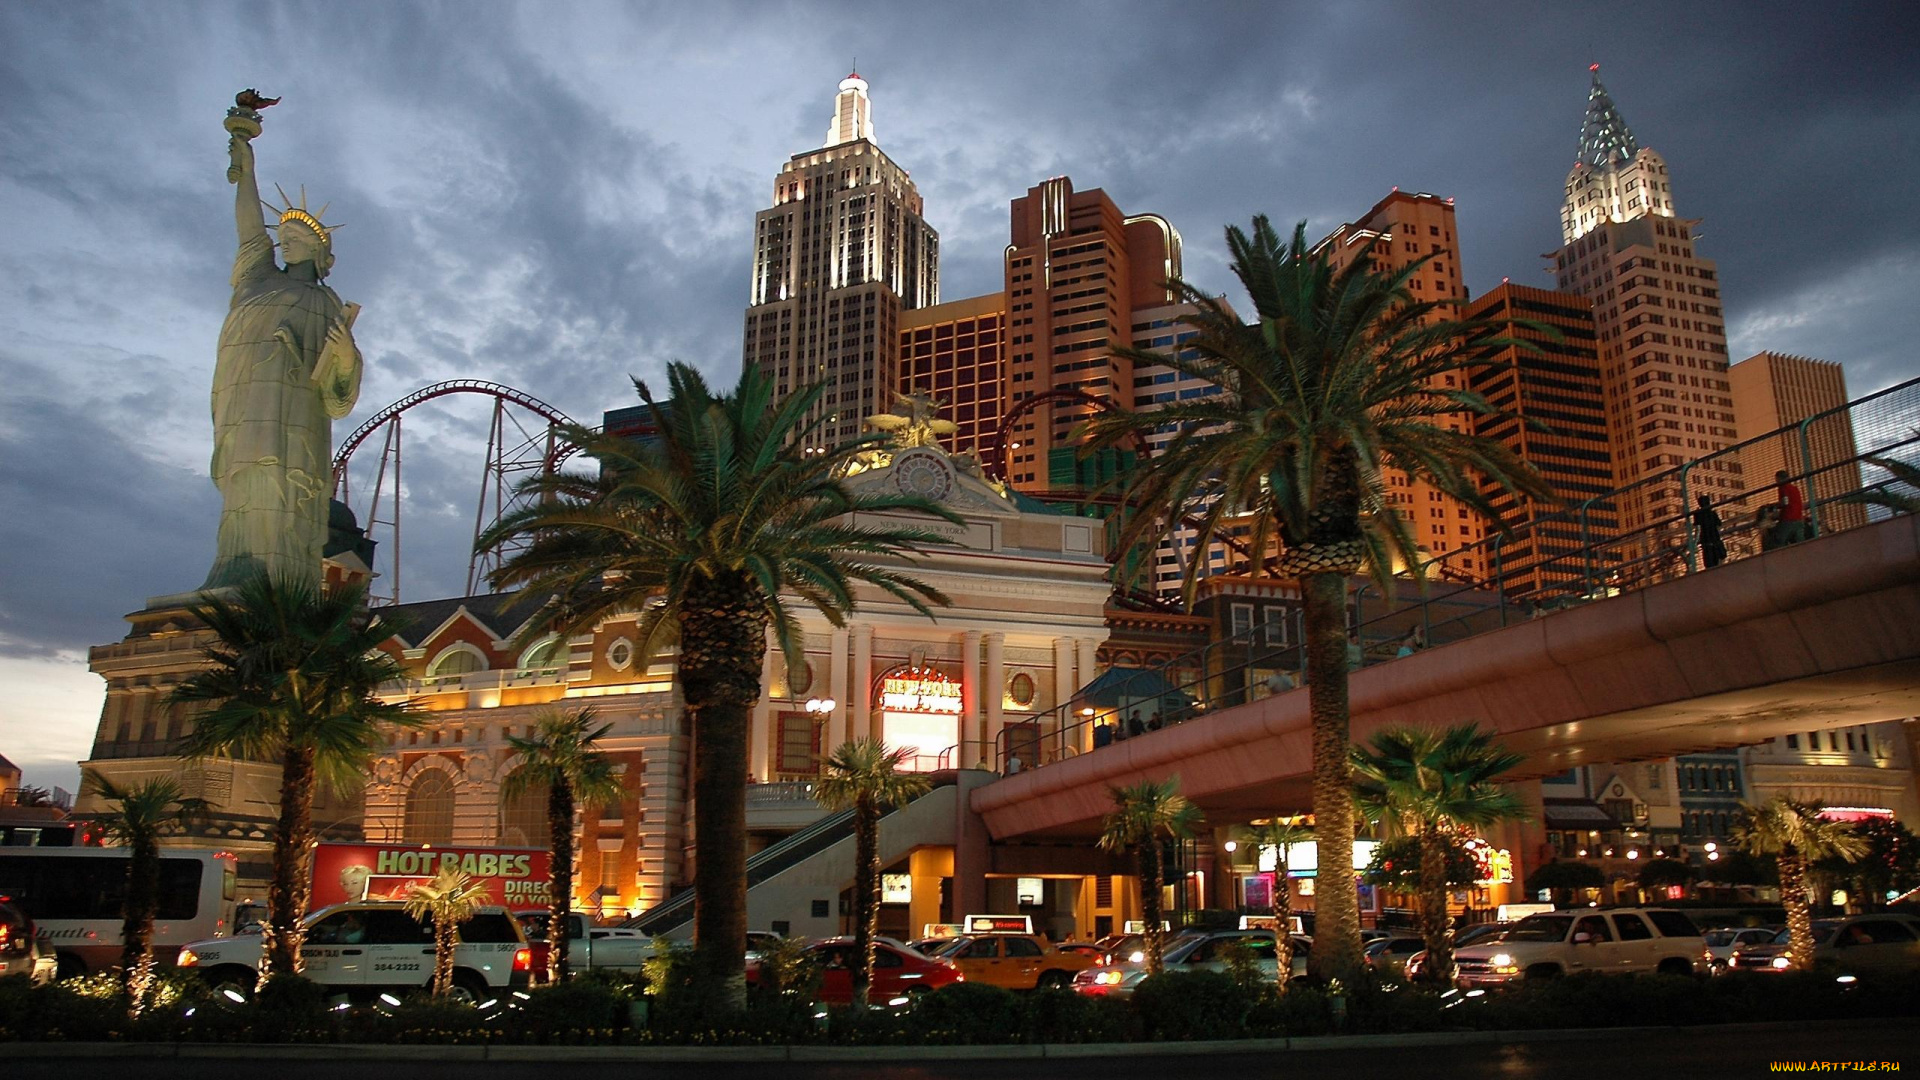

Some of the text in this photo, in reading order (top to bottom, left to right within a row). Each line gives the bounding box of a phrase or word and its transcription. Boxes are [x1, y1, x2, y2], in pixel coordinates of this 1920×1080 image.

[944, 526, 966, 535] YORK
[885, 679, 962, 696] NEW YORK
[377, 851, 436, 874] HOT
[505, 881, 552, 894] DIREC
[504, 894, 525, 905] TO
[200, 951, 220, 960] 5805
[374, 963, 420, 971] 384-2322
